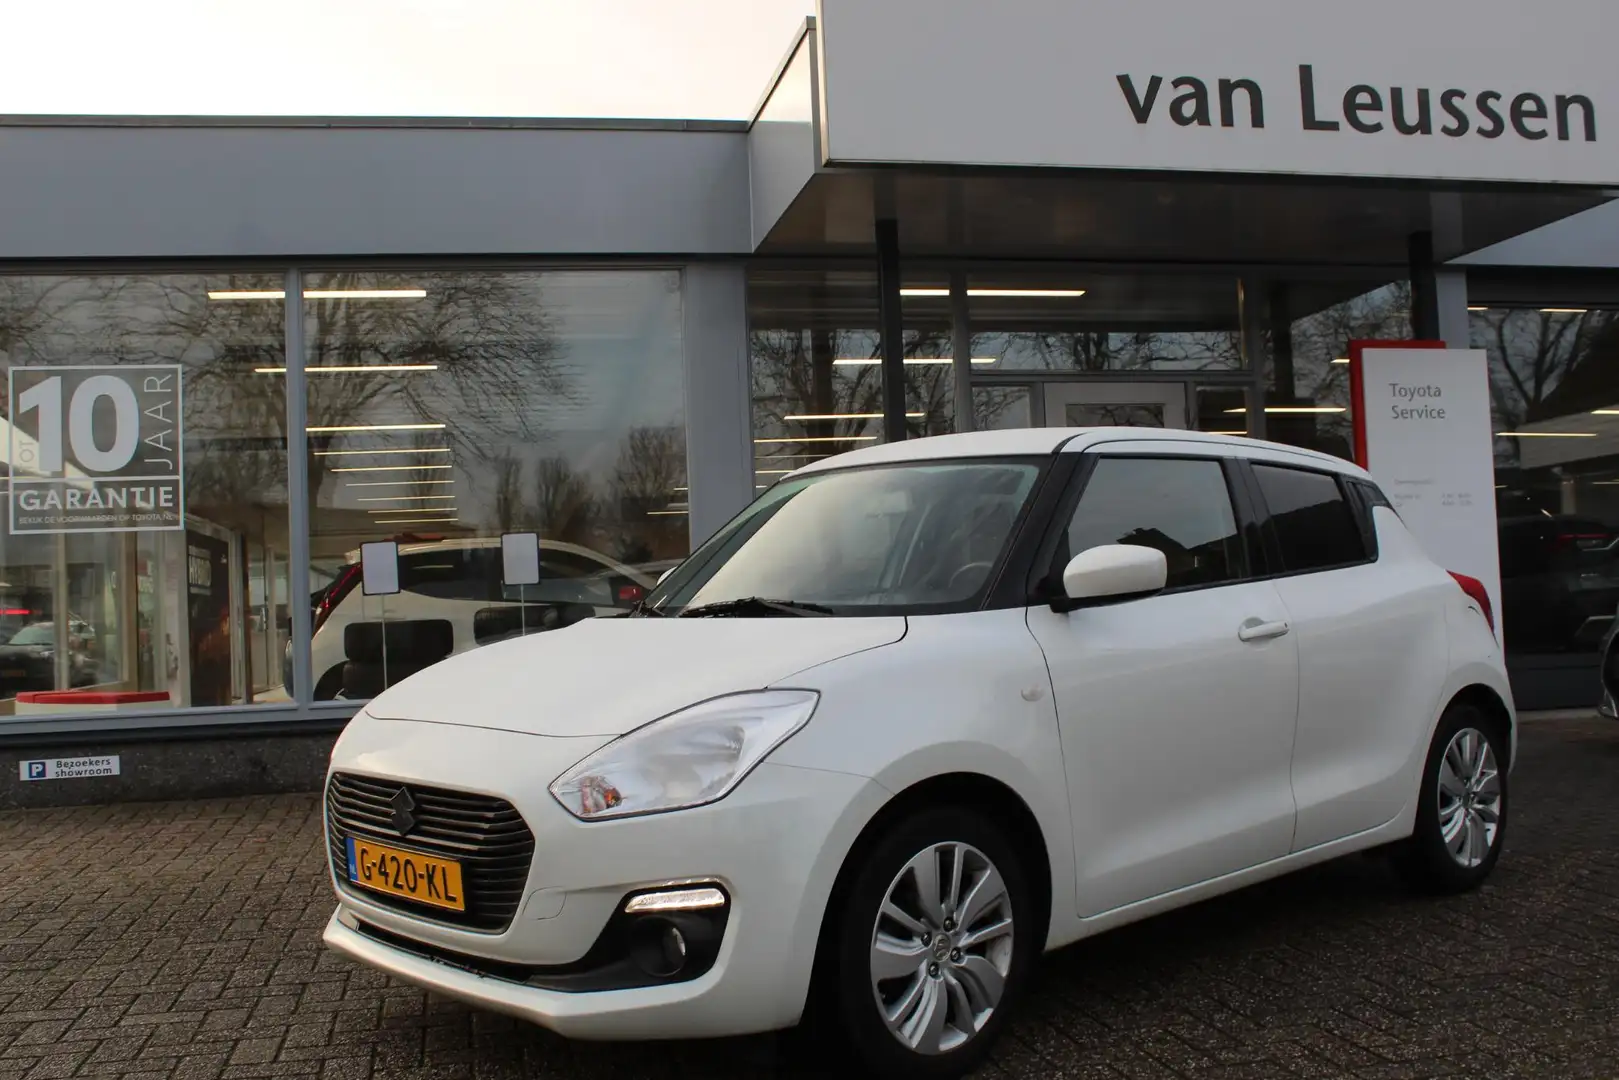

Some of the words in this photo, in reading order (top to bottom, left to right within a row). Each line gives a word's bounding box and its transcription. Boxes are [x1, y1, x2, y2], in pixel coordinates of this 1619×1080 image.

[1116, 73, 1265, 128] van
[1298, 64, 1597, 142] Leussen
[1389, 383, 1442, 401] Toyota
[19, 375, 139, 472] 10
[144, 374, 173, 470] JAAR
[1391, 405, 1446, 419] Service
[19, 486, 173, 511] GARANTIE
[55, 767, 112, 777] showroom
[56, 758, 111, 769] Bezoekers
[360, 847, 457, 902] G-420-KL
